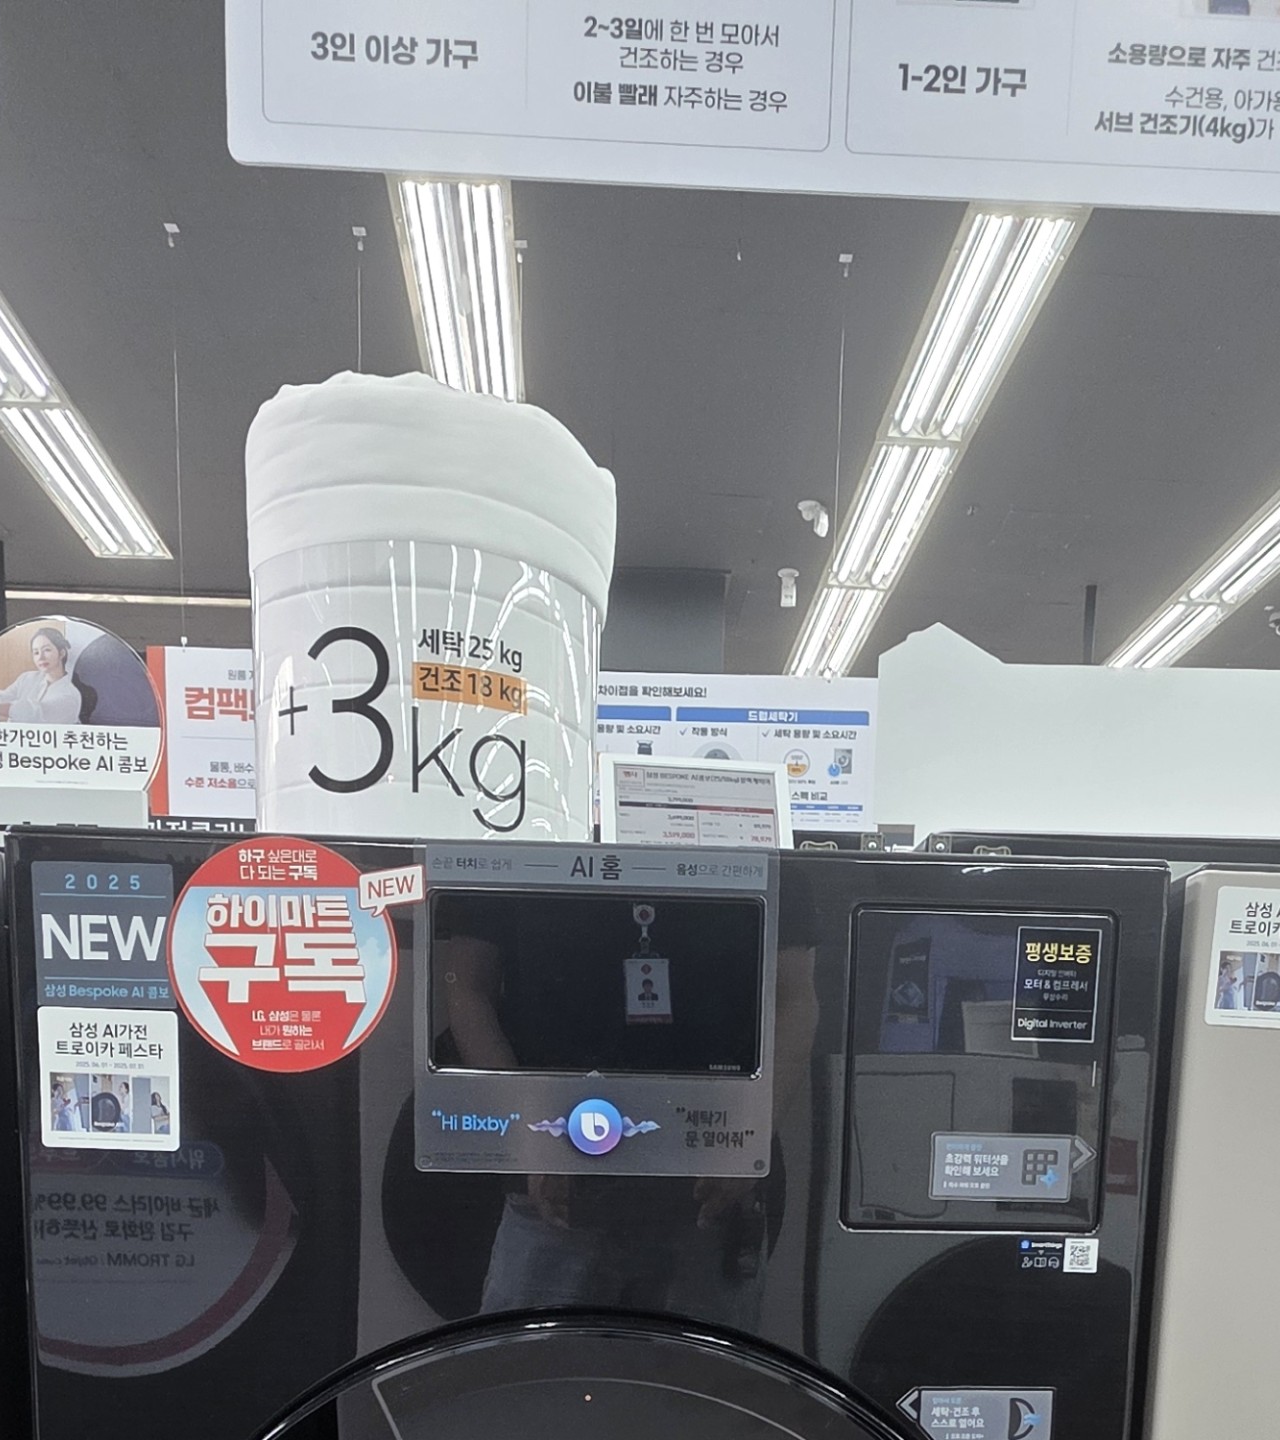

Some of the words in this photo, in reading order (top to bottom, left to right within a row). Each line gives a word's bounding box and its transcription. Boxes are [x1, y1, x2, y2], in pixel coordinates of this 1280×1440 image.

[584, 16, 664, 42] 2~3일에
[670, 19, 690, 43] 한
[696, 20, 716, 44] 번
[720, 22, 780, 48] 모아서
[310, 32, 356, 62] 3인
[365, 35, 418, 65] 이상
[426, 37, 479, 69] 가구
[619, 46, 699, 72] 건조하는
[705, 48, 744, 74] 경우
[1107, 42, 1207, 69] 소용량으로
[1212, 46, 1251, 71] 자주
[897, 63, 968, 95] 1-2인
[975, 66, 1027, 97] 가구
[573, 81, 612, 105] 이불
[618, 82, 658, 107] 빨래
[663, 84, 743, 111] 자주하는
[748, 88, 788, 113] 경우
[1165, 86, 1227, 112] 수건용,
[1094, 111, 1134, 135] 서브
[1139, 113, 1274, 144] 건조기(4kg)가
[418, 627, 465, 659] 세탁
[469, 636, 493, 662] 25
[500, 637, 522, 671] kg
[419, 666, 461, 693] 건조
[467, 672, 492, 697] 18
[498, 675, 523, 707] kg
[642, 686, 707, 698] 확인해보세요!
[185, 687, 254, 721] 컴팩
[747, 711, 798, 722] 드럼세탁기
[62, 730, 129, 751] 추천하는
[8, 752, 91, 775] Bespoke
[96, 756, 114, 772] AI
[117, 755, 149, 773] 콤보
[240, 866, 254, 880] 다
[258, 866, 286, 880] 되는
[288, 866, 317, 880] 구독
[571, 856, 593, 877] AI
[600, 855, 623, 880] 홈
[677, 863, 719, 876] 음성으로
[722, 864, 763, 877] 간편하게
[64, 873, 141, 891] 2025
[367, 875, 415, 899] NEW
[206, 893, 352, 929] 하이마트
[1245, 901, 1273, 919] 삼성
[41, 913, 166, 961] NEW
[1025, 942, 1092, 964] 평생보증
[199, 932, 367, 1004] 구독
[44, 984, 67, 998] 삼성
[69, 985, 129, 1001] Bespoke
[132, 986, 145, 998] AI
[148, 986, 170, 999] 콤보
[1024, 979, 1042, 989] 모터
[69, 1022, 98, 1039] 삼성
[102, 1023, 147, 1041] AI가전
[1018, 1018, 1048, 1030] Digital
[1050, 1020, 1087, 1029] Inverter
[55, 1041, 115, 1058] 트로이카
[119, 1042, 163, 1060] 페스타
[931, 1419, 957, 1427] 스스로
